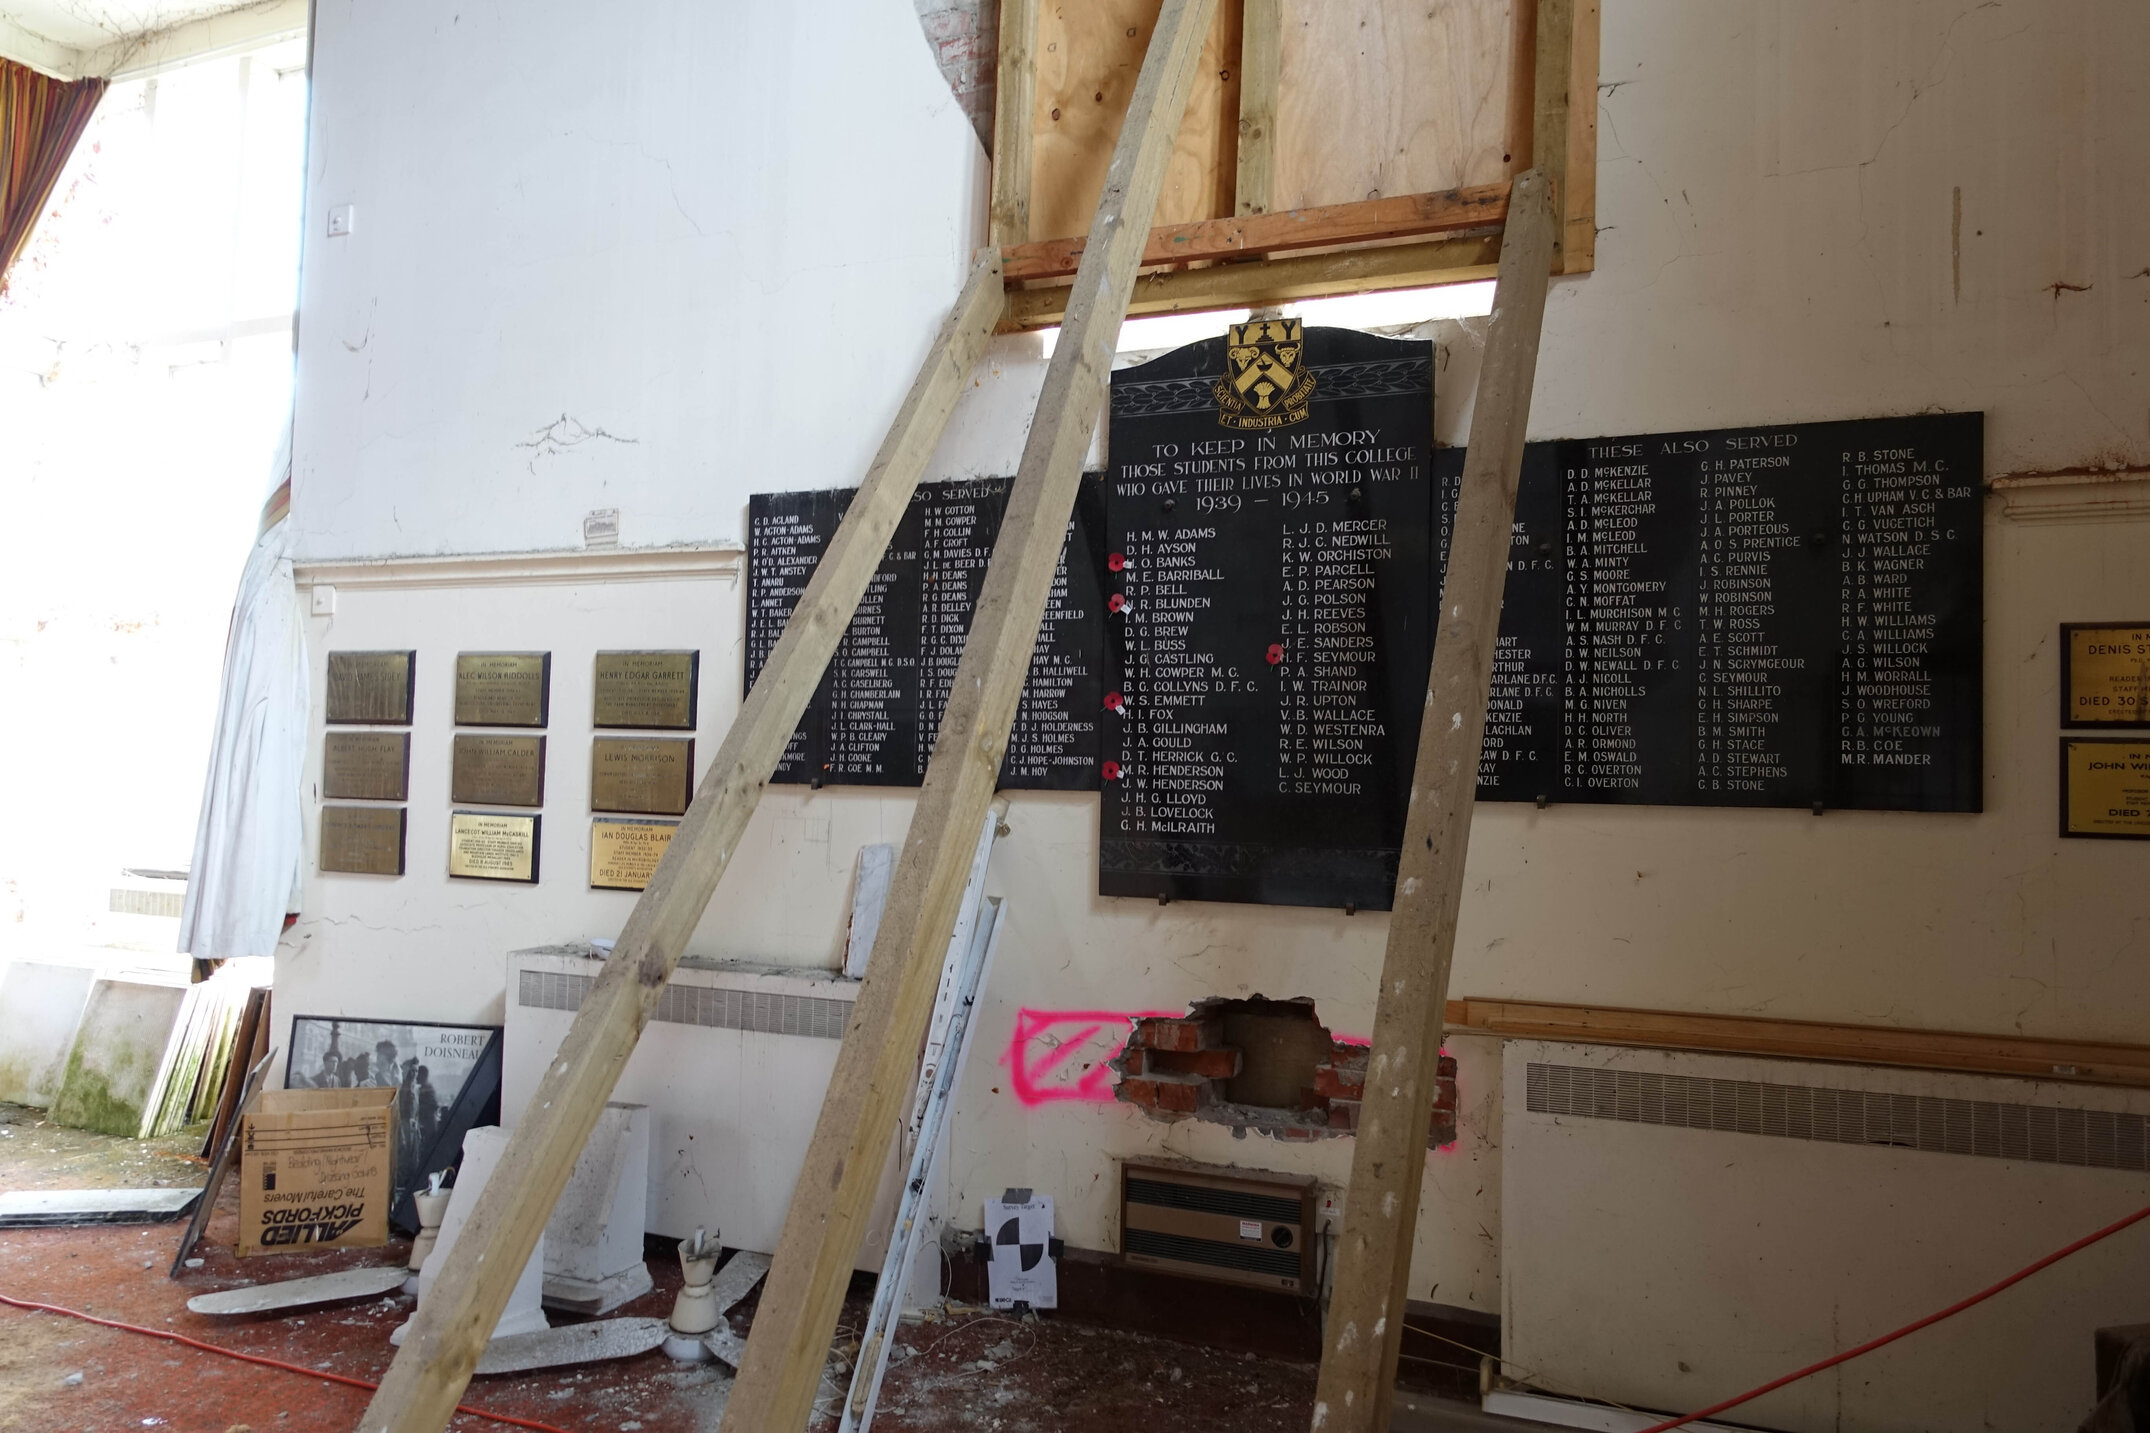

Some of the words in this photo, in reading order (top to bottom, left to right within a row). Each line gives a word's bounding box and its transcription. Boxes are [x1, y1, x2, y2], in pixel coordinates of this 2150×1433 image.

[1284, 378, 1315, 407] PROBITATE
[1215, 386, 1242, 411] SCIENTIA
[1221, 415, 1232, 423] ET
[1239, 417, 1282, 427] INDUSTRIA
[1289, 409, 1307, 422] CUM
[1153, 444, 1178, 458] TO
[1191, 439, 1244, 455] KEEP
[1257, 437, 1276, 451] IN
[1290, 429, 1380, 448] MEMORY
[1588, 444, 1643, 459] THESE
[1661, 440, 1709, 455] ALSO
[1726, 434, 1797, 450] SERVED
[1121, 463, 1166, 478] THOSE
[1174, 458, 1245, 474] STUDENTS
[1254, 455, 1296, 470] FROM
[1305, 452, 1337, 467] THIS
[1345, 447, 1416, 464] COLLEGE
[1117, 483, 1145, 496] WHO
[1152, 480, 1187, 495] GAVE
[1196, 478, 1233, 492] THEIR
[1242, 475, 1281, 490] LIVES
[1289, 473, 1302, 487] IN
[1311, 471, 1361, 485] WORLD
[1370, 467, 1401, 481] WAR
[1410, 467, 1419, 479] II
[1715, 472, 1752, 483] PAVEY
[943, 488, 989, 500] SERVED
[1715, 485, 1757, 497] PINNEY
[1196, 495, 1241, 515] 1939
[1281, 491, 1329, 509] 1945
[771, 547, 796, 556] AITKEN
[1593, 544, 1647, 555] MITCHELL
[1126, 572, 1138, 582] M.
[1143, 572, 1154, 581] E.
[1158, 569, 1224, 581] BARRIBALL
[1282, 566, 1294, 577] E.
[1299, 566, 1309, 576] P.
[1315, 564, 1375, 576] PARCELL
[761, 577, 783, 587] ANARU
[1283, 581, 1293, 591] A.
[1299, 580, 1309, 590] D.
[1315, 578, 1375, 590] PEARSON
[1714, 578, 1771, 589] ROBINSON
[1126, 586, 1136, 596] R.
[1141, 585, 1150, 595] P.
[1156, 584, 1187, 595] BELL
[761, 598, 782, 607] ANNET
[941, 613, 959, 622] DICK
[940, 625, 964, 633] DIXON
[1125, 627, 1134, 637] D.
[1140, 627, 1150, 636] G.
[1154, 626, 1188, 636] BREW
[1282, 624, 1292, 634] E.
[1298, 624, 1309, 633] L.
[1314, 623, 1366, 633] ROBSON
[1125, 641, 1136, 651] W.
[1141, 641, 1150, 650] L.
[1154, 640, 1186, 650] BUSS
[2089, 645, 2131, 654] DENIS
[1857, 685, 1931, 695] WOODHOUSE
[2080, 697, 2110, 705] DIED
[2118, 697, 2135, 705] 30
[1123, 738, 1132, 747] J.
[1138, 738, 1149, 747] A.
[1153, 738, 1191, 747] GOULD
[632, 754, 675, 762] MORRISON
[848, 753, 872, 762] COOKE
[1280, 753, 1291, 763] W.
[1297, 754, 1307, 764] P.
[1314, 754, 1372, 765] WILLOCK
[1593, 752, 1637, 762] OSWALD
[2088, 762, 2124, 770] JOHN
[1032, 768, 1047, 776] HOY
[1122, 779, 1131, 788] J.
[1137, 779, 1148, 789] W.
[1153, 779, 1223, 790] HENDERSON
[1279, 782, 1290, 792] C.
[1295, 783, 1361, 794] SEYMOUR
[616, 832, 648, 840] DOUGLAS
[600, 869, 614, 877] DIED
[441, 1033, 485, 1046] ROBERT
[264, 1192, 303, 1203] Movers
[304, 1188, 343, 1202] Careful
[346, 1187, 364, 1198] The
[262, 1203, 364, 1224] PICKFORDS
[261, 1218, 364, 1245] ALLIED
